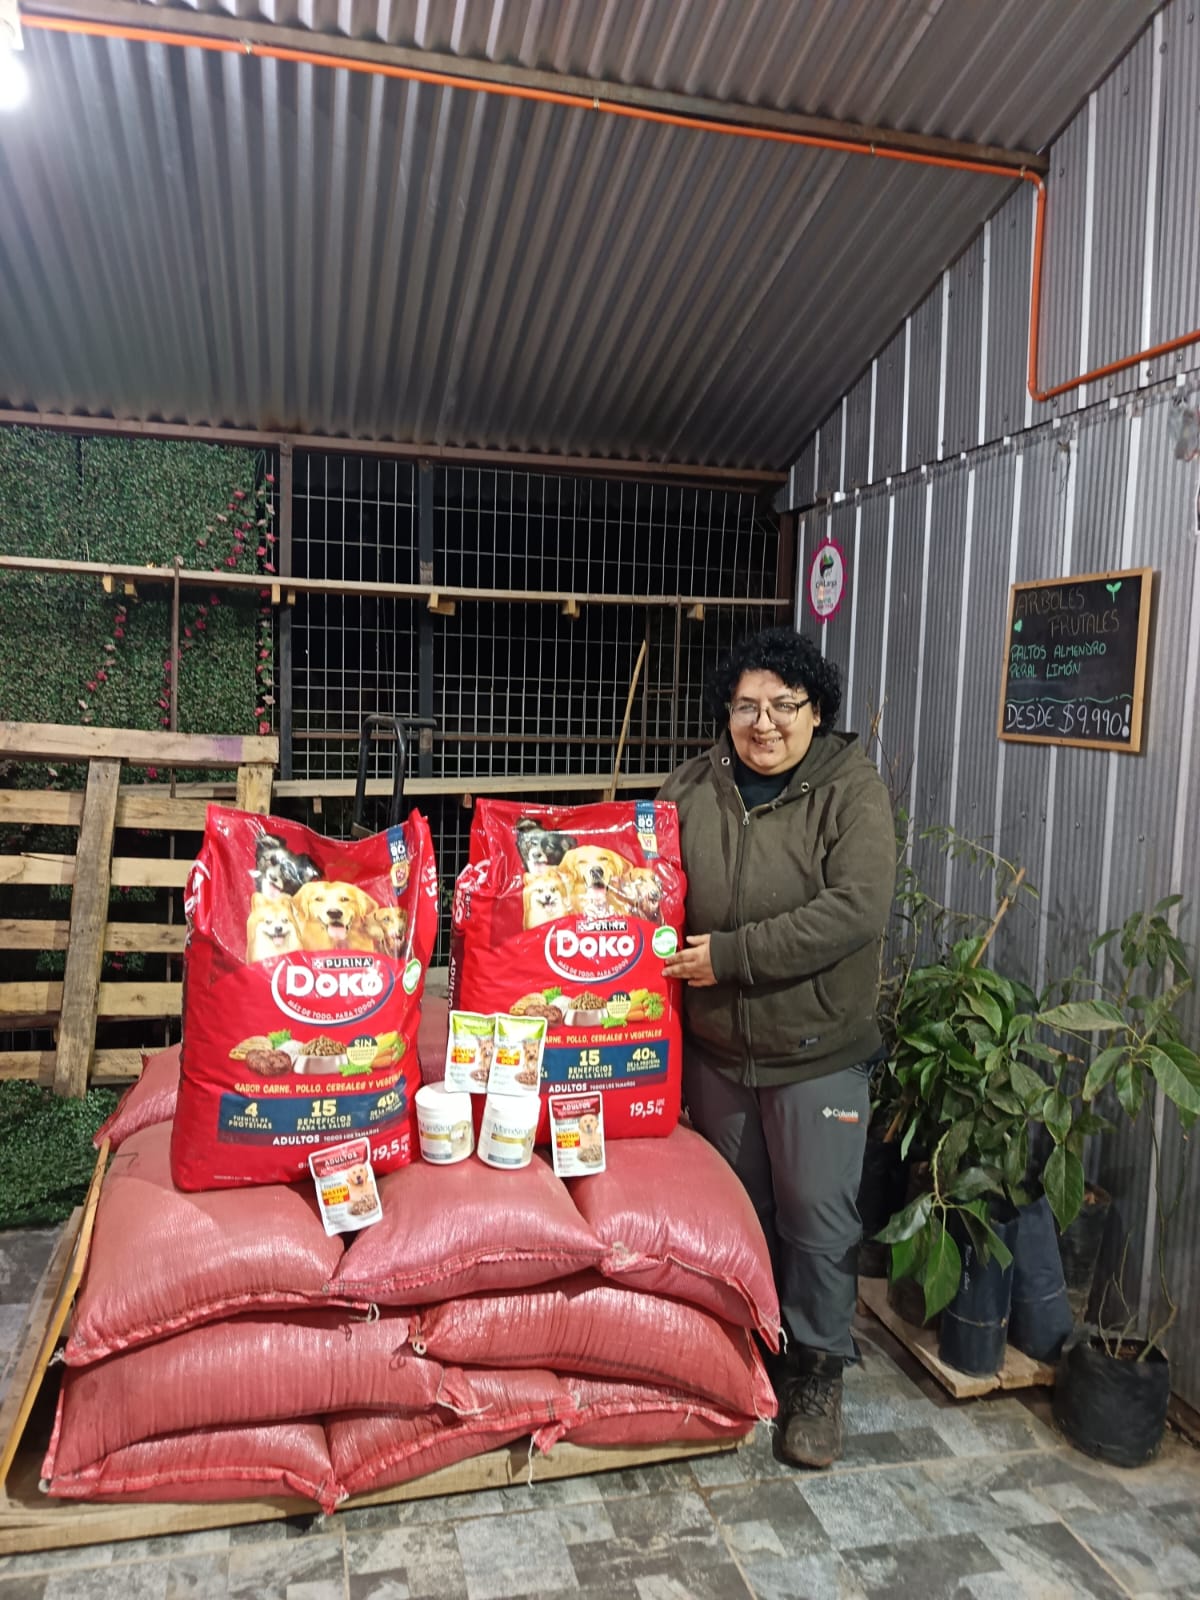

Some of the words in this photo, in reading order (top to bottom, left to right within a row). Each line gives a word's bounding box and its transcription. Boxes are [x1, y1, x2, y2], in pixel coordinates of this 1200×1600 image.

[1048, 608, 1120, 638] FRUTALES
[1011, 644, 1047, 663] PALTOS
[1053, 640, 1106, 660] ALMENDRO
[1006, 703, 1054, 730] DESDE
[325, 958, 373, 968] PURINA
[354, 1038, 372, 1048] SIN
[591, 1033, 623, 1043] CEREALES
[630, 1029, 663, 1040] VEGETALES
[579, 1049, 600, 1066] 15
[568, 1064, 612, 1074] BENEFICIOS
[326, 1081, 366, 1092] CEREALES
[368, 1080, 373, 1088] Y
[548, 1083, 587, 1093] ADULTOS
[245, 1102, 258, 1117] 4
[311, 1099, 337, 1117] 15
[562, 1102, 591, 1111] ADULTOS
[629, 1101, 655, 1119] 19,5
[297, 1114, 352, 1126] BENEFICIOS
[273, 1135, 320, 1145] ADULTOS
[373, 1139, 400, 1161] 19,5
[325, 1151, 358, 1166] ADULTOS
